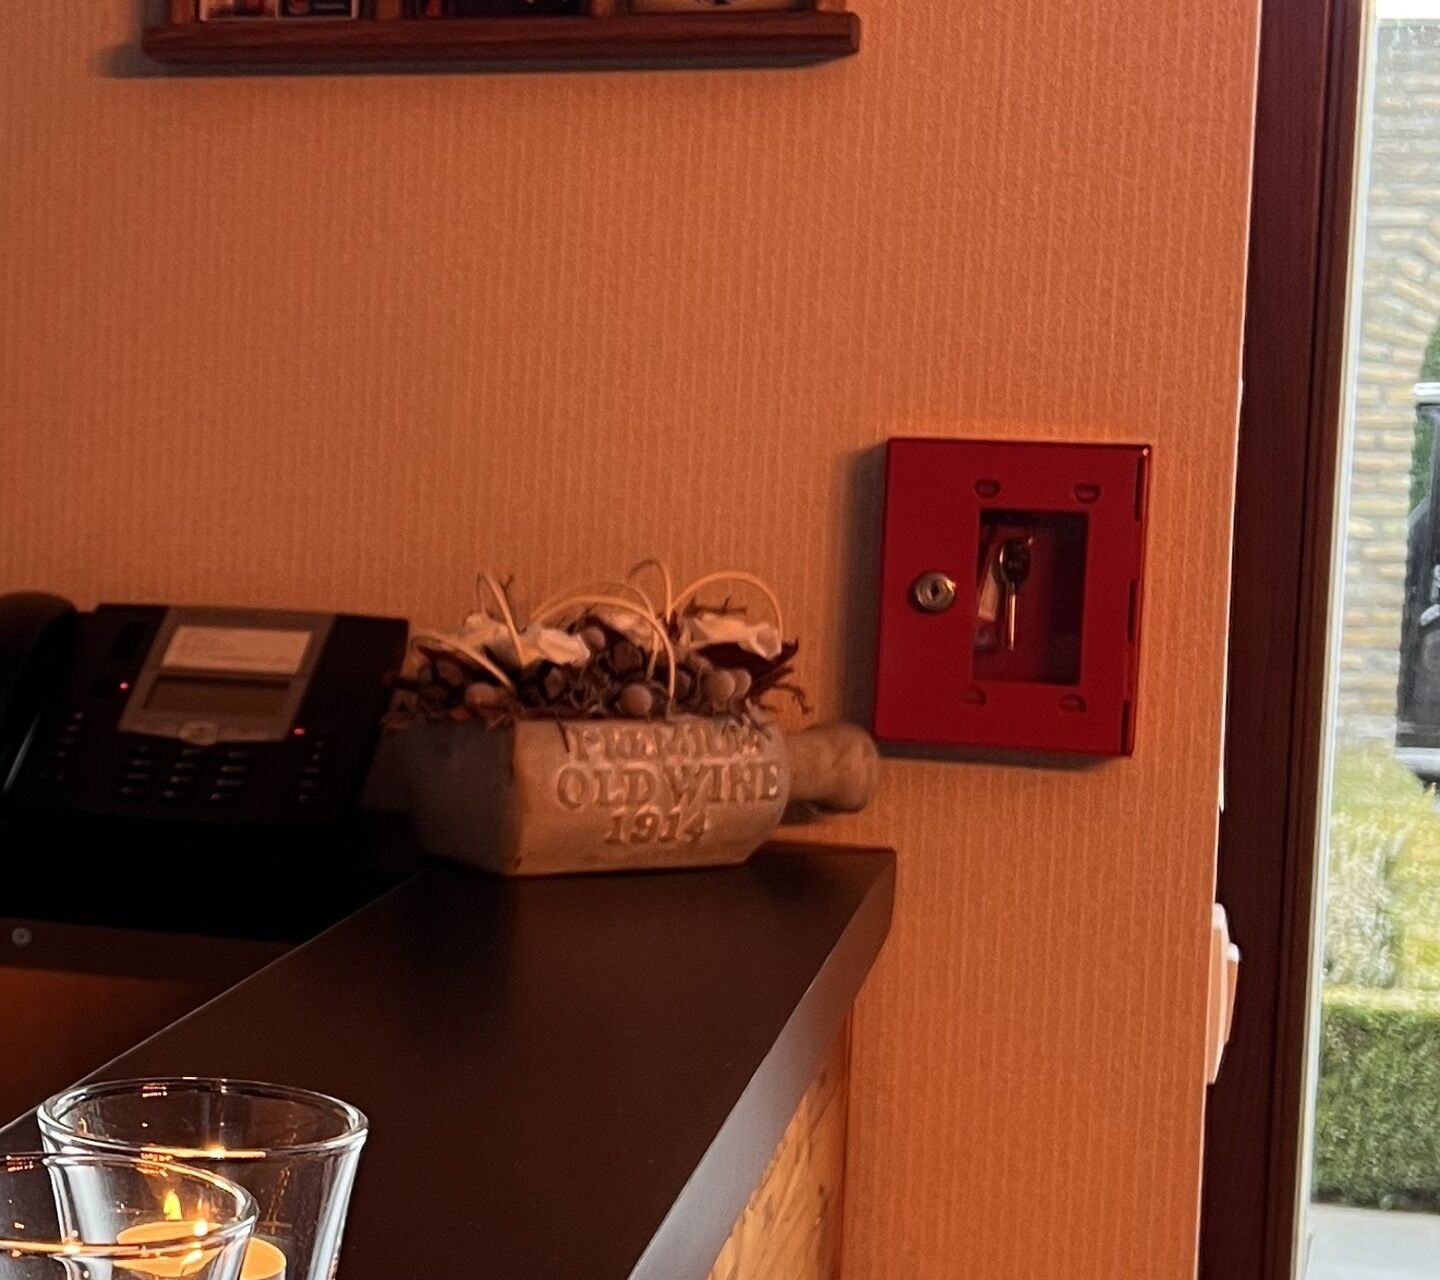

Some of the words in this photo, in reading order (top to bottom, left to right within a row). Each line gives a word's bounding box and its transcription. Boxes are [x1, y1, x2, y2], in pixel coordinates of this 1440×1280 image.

[557, 766, 661, 810] OLD
[662, 761, 780, 810] WINE
[603, 810, 708, 845] 1914
